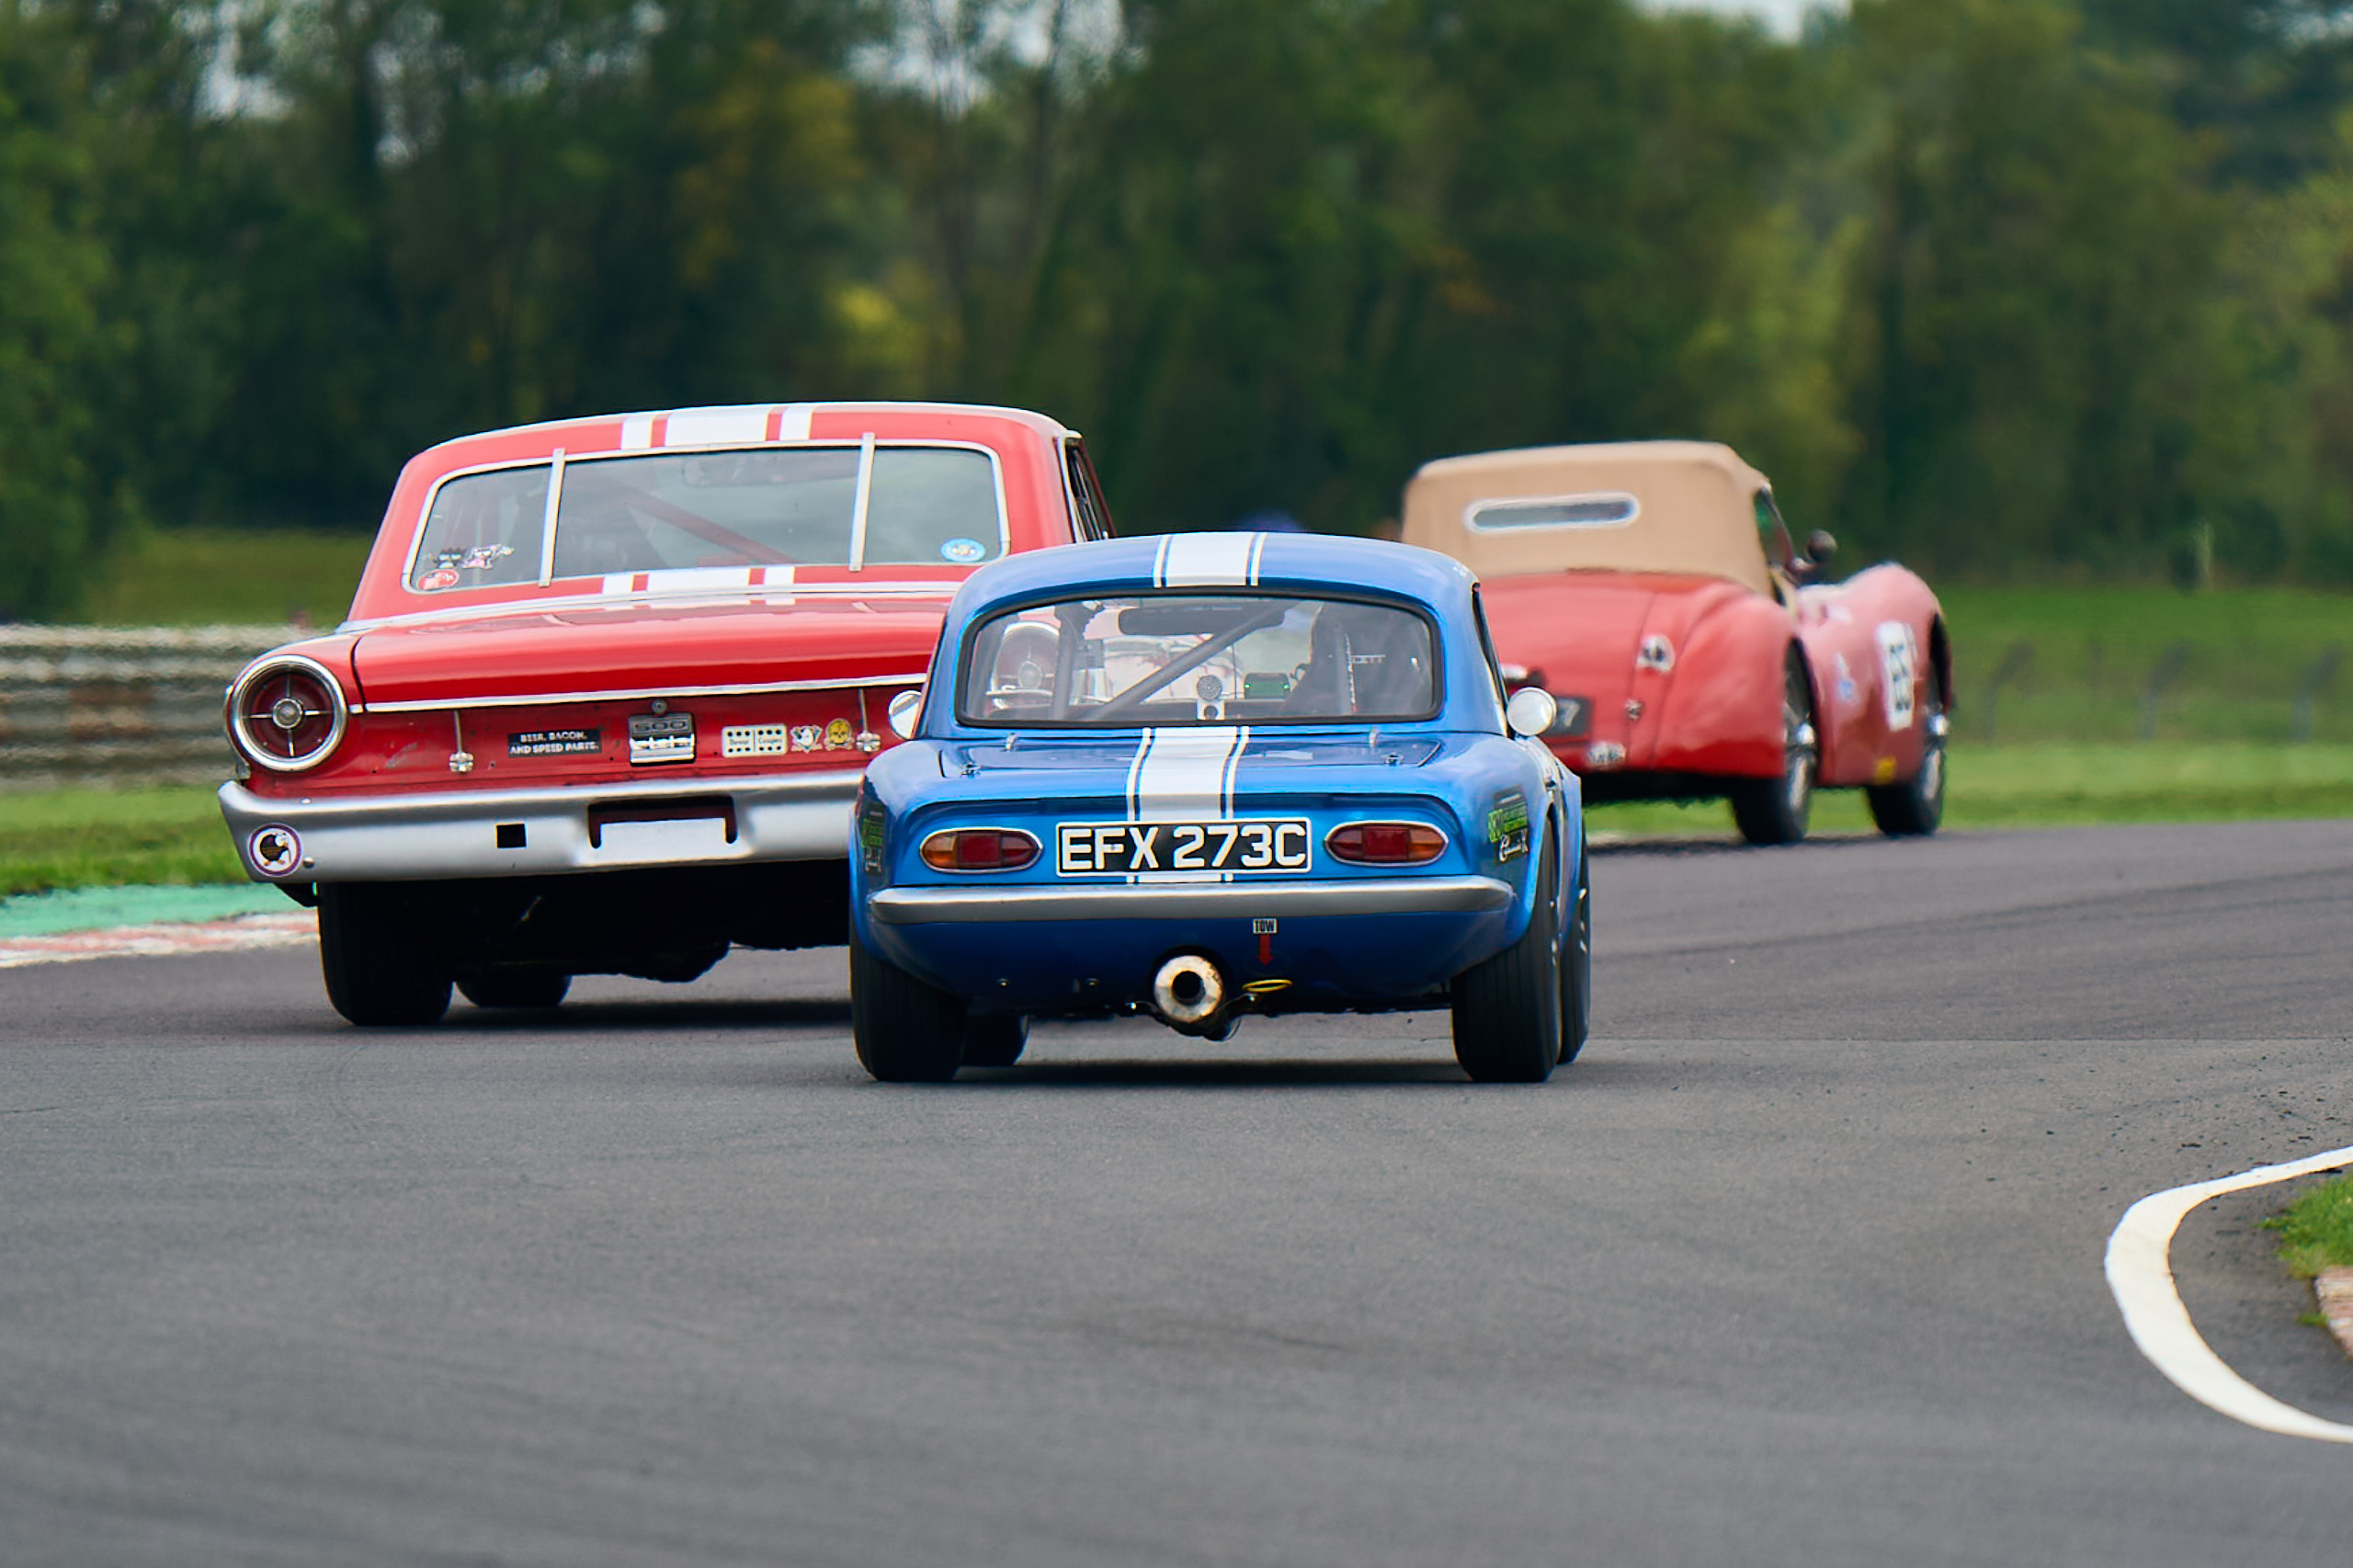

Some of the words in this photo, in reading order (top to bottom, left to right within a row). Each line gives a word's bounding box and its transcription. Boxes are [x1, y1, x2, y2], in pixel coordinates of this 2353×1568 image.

[549, 731, 586, 741] BACON.
[510, 744, 531, 754] AND
[533, 743, 563, 753] SPEED
[565, 741, 599, 751] PARTS.
[1061, 826, 1159, 869] EFX
[1173, 823, 1306, 868] 273C
[1254, 919, 1276, 932] TOW
